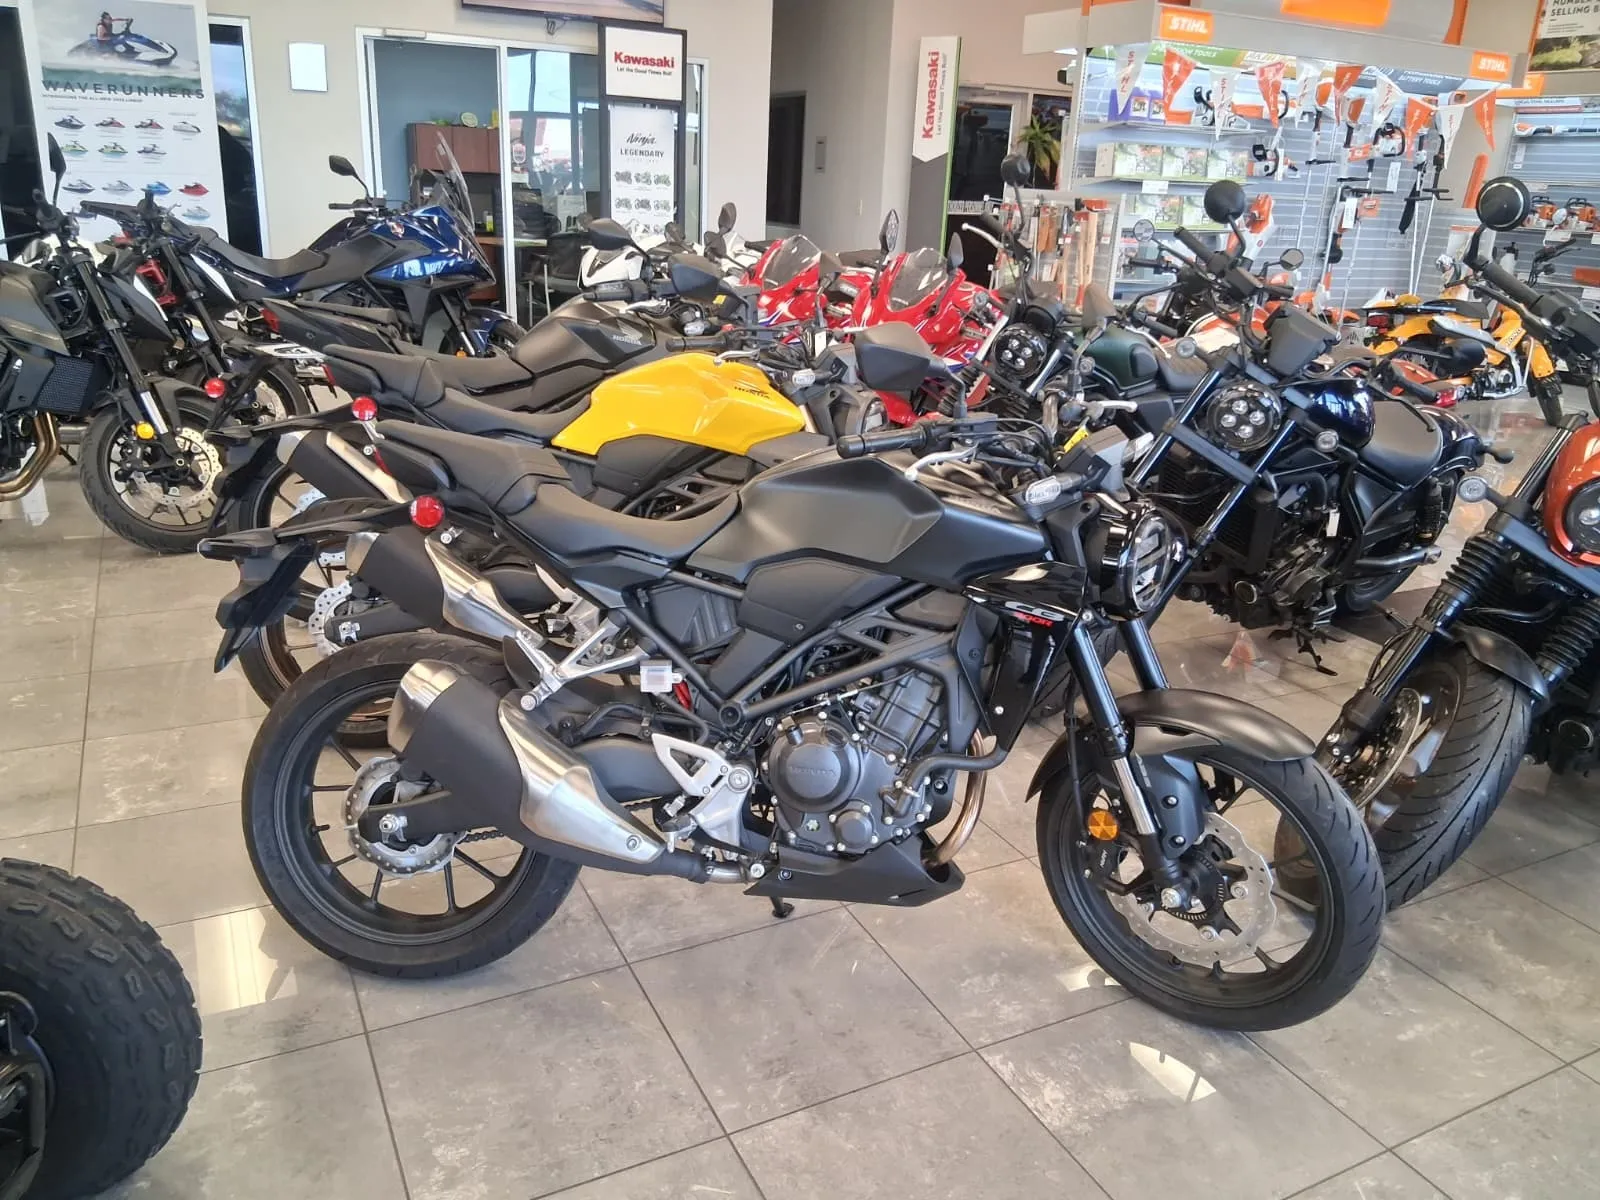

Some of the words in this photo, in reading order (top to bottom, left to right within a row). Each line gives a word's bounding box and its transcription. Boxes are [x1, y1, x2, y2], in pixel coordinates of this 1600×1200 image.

[1551, 5, 1590, 16] SELLING
[1169, 15, 1208, 34] STIHL
[614, 51, 675, 68] Kawasaki
[1477, 57, 1507, 73] STIHL
[42, 80, 205, 99] WAVERUNNERS
[921, 51, 940, 139] Kawasaki
[626, 132, 656, 146] Ninja
[620, 148, 664, 158] LEGENDARY
